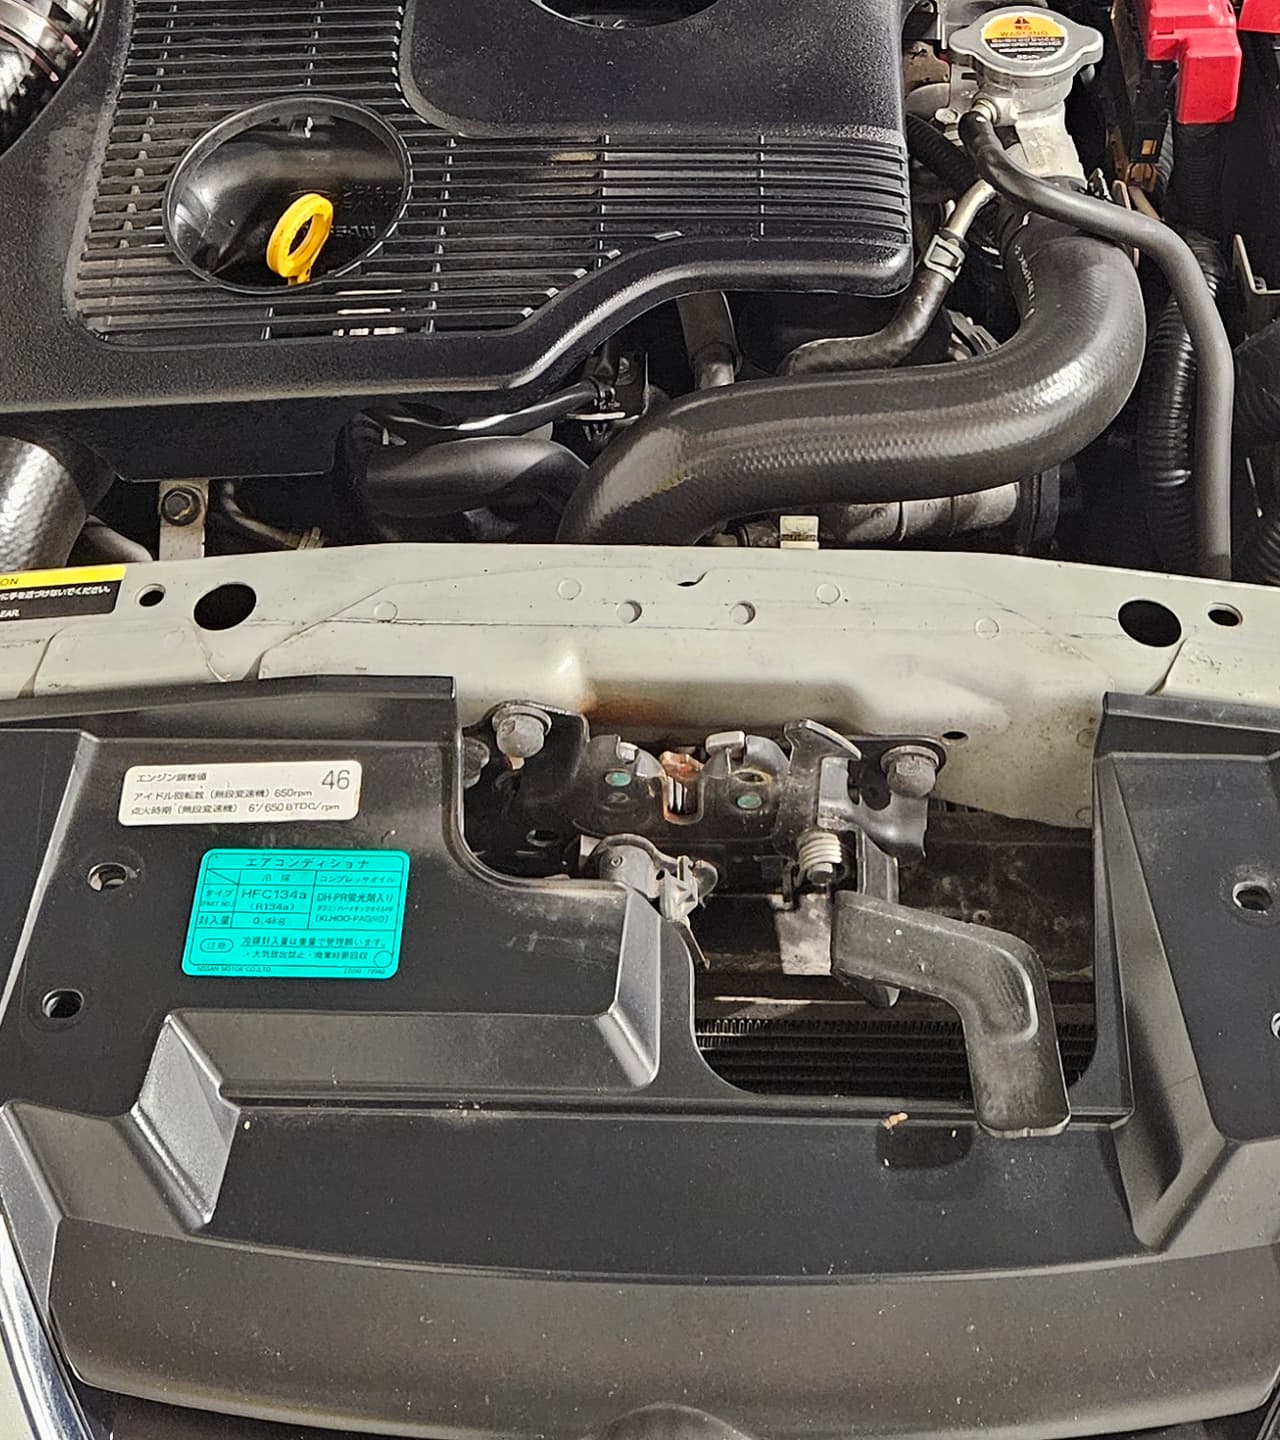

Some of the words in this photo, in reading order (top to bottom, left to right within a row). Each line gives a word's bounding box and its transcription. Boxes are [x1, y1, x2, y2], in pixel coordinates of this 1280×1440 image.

[321, 769, 351, 791] 46
[246, 857, 369, 869] エアコンディショナ
[206, 888, 234, 897] タイプ
[241, 889, 307, 900] HFC134a
[250, 902, 295, 911] (R134a)
[253, 916, 287, 926] 0.4kg
